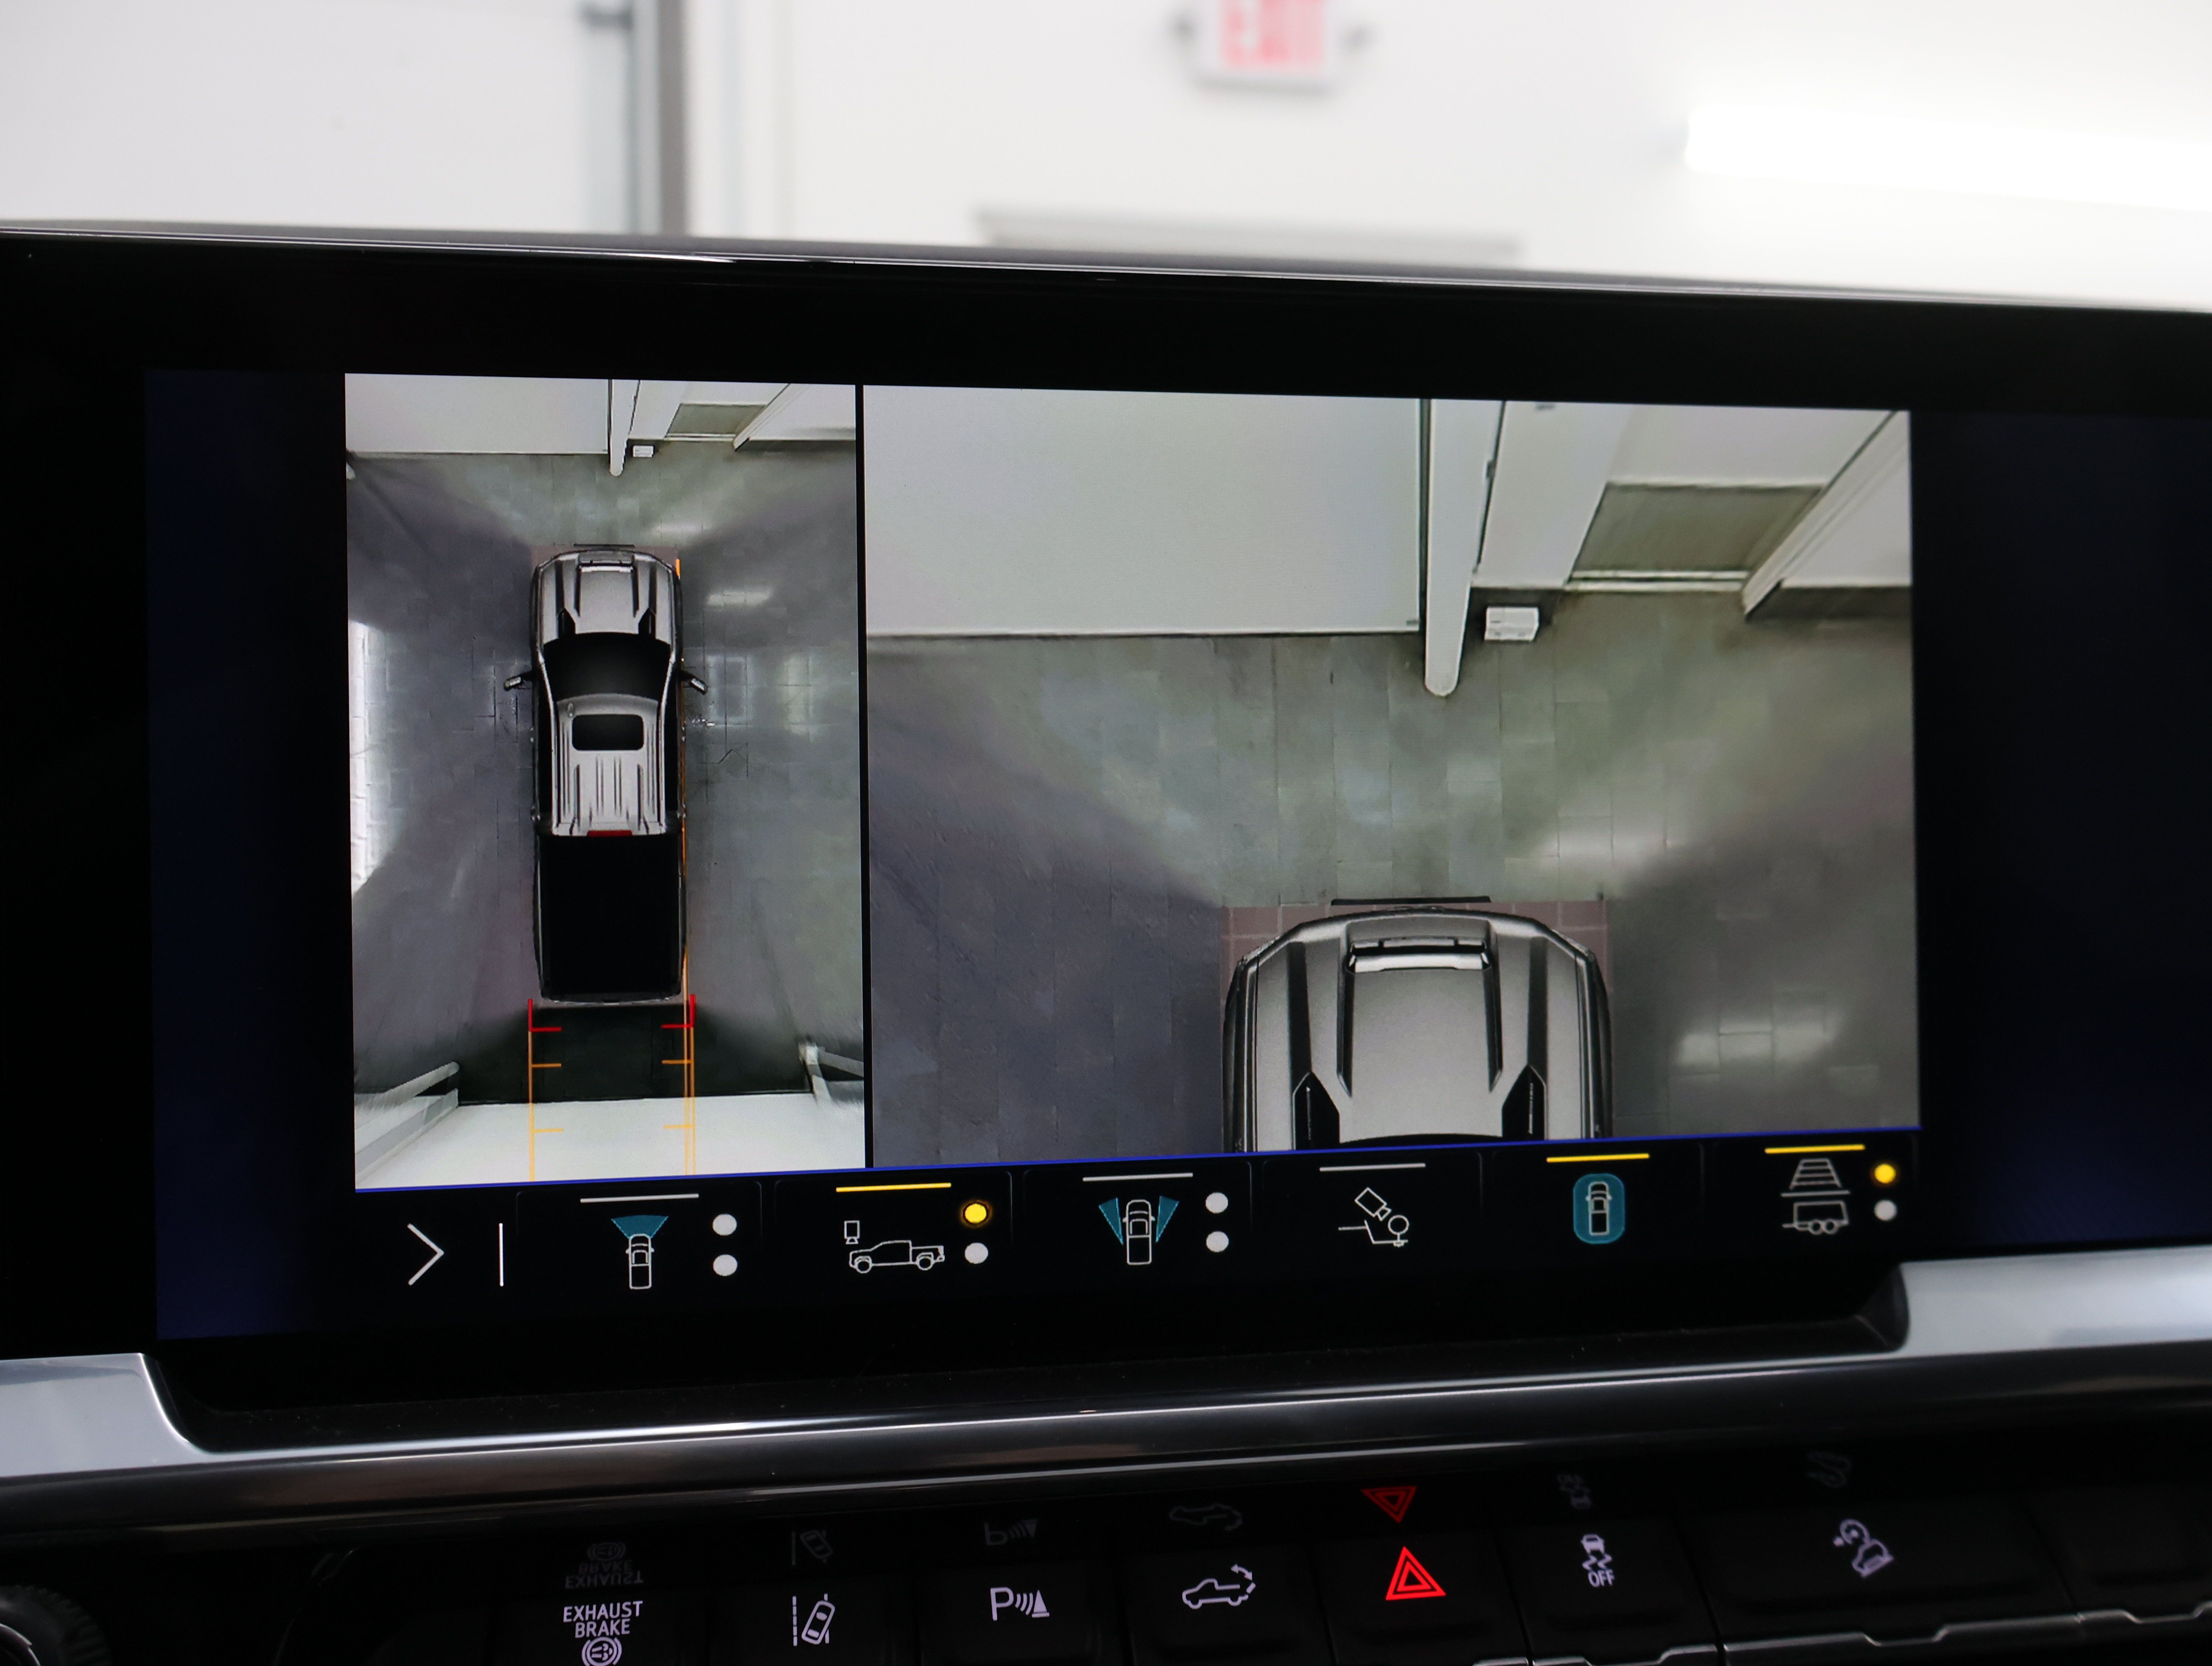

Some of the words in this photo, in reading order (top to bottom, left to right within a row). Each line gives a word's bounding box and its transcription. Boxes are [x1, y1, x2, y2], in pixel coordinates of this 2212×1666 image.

[1588, 1569, 1615, 1588] OFF
[563, 1600, 643, 1623] EXHAUST
[575, 1618, 631, 1638] BRAKE
